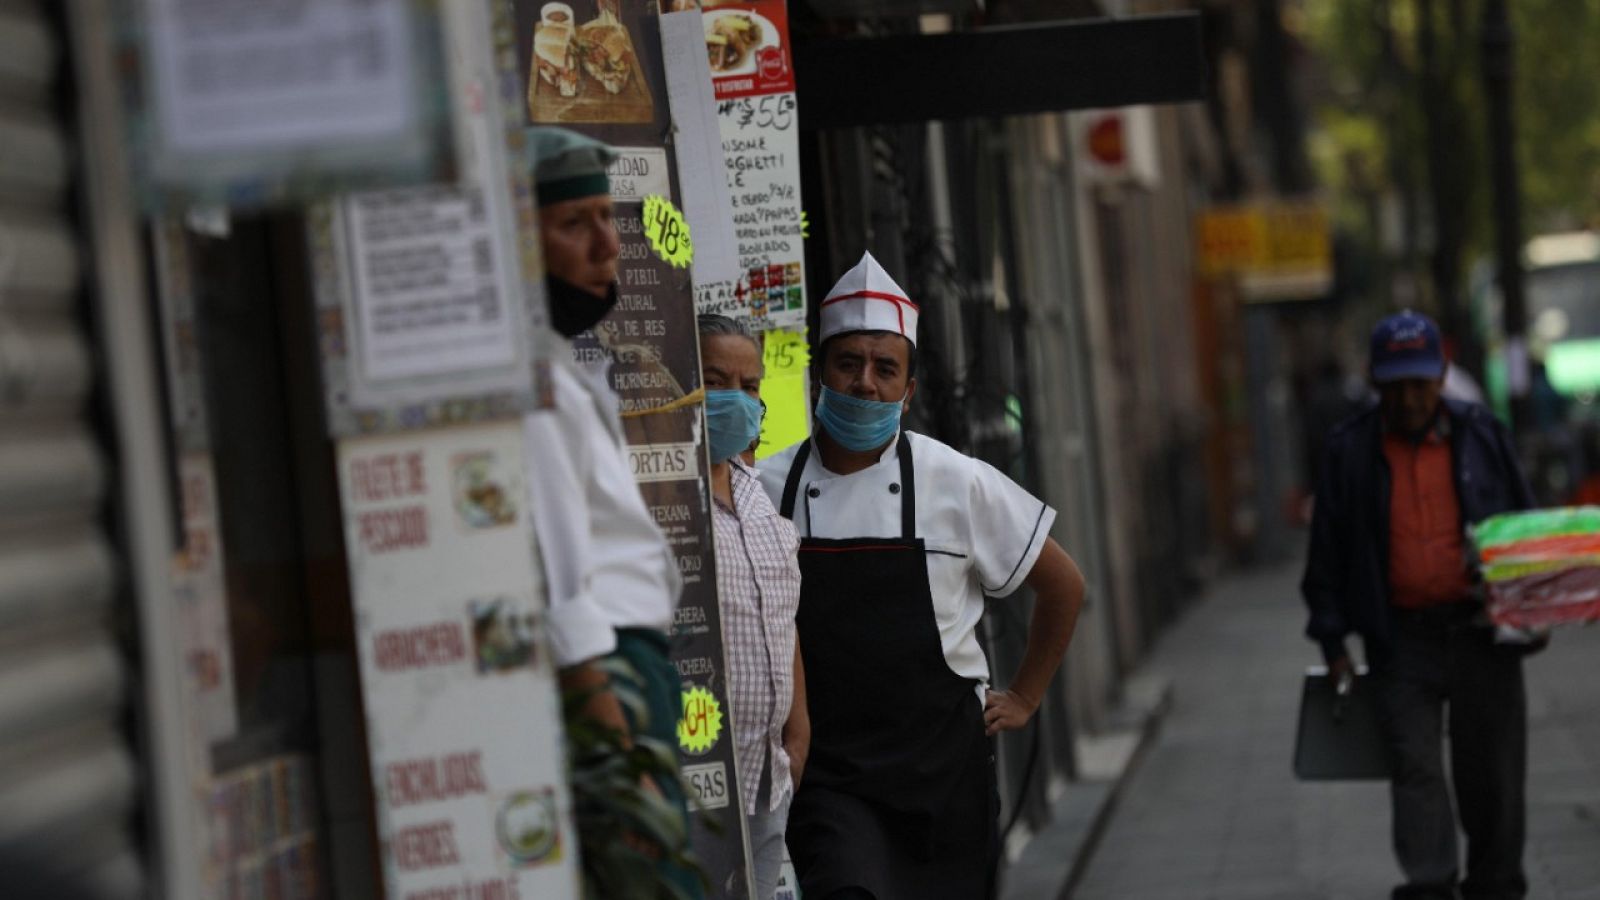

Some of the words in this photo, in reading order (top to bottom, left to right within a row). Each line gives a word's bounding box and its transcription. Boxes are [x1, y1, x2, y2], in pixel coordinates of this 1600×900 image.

[626, 268, 661, 286] PIBIL
[614, 294, 657, 312] ATURAL
[624, 320, 640, 336] DE
[645, 319, 667, 336] RES
[628, 449, 687, 475] ORTAS
[690, 770, 726, 800] SAS
